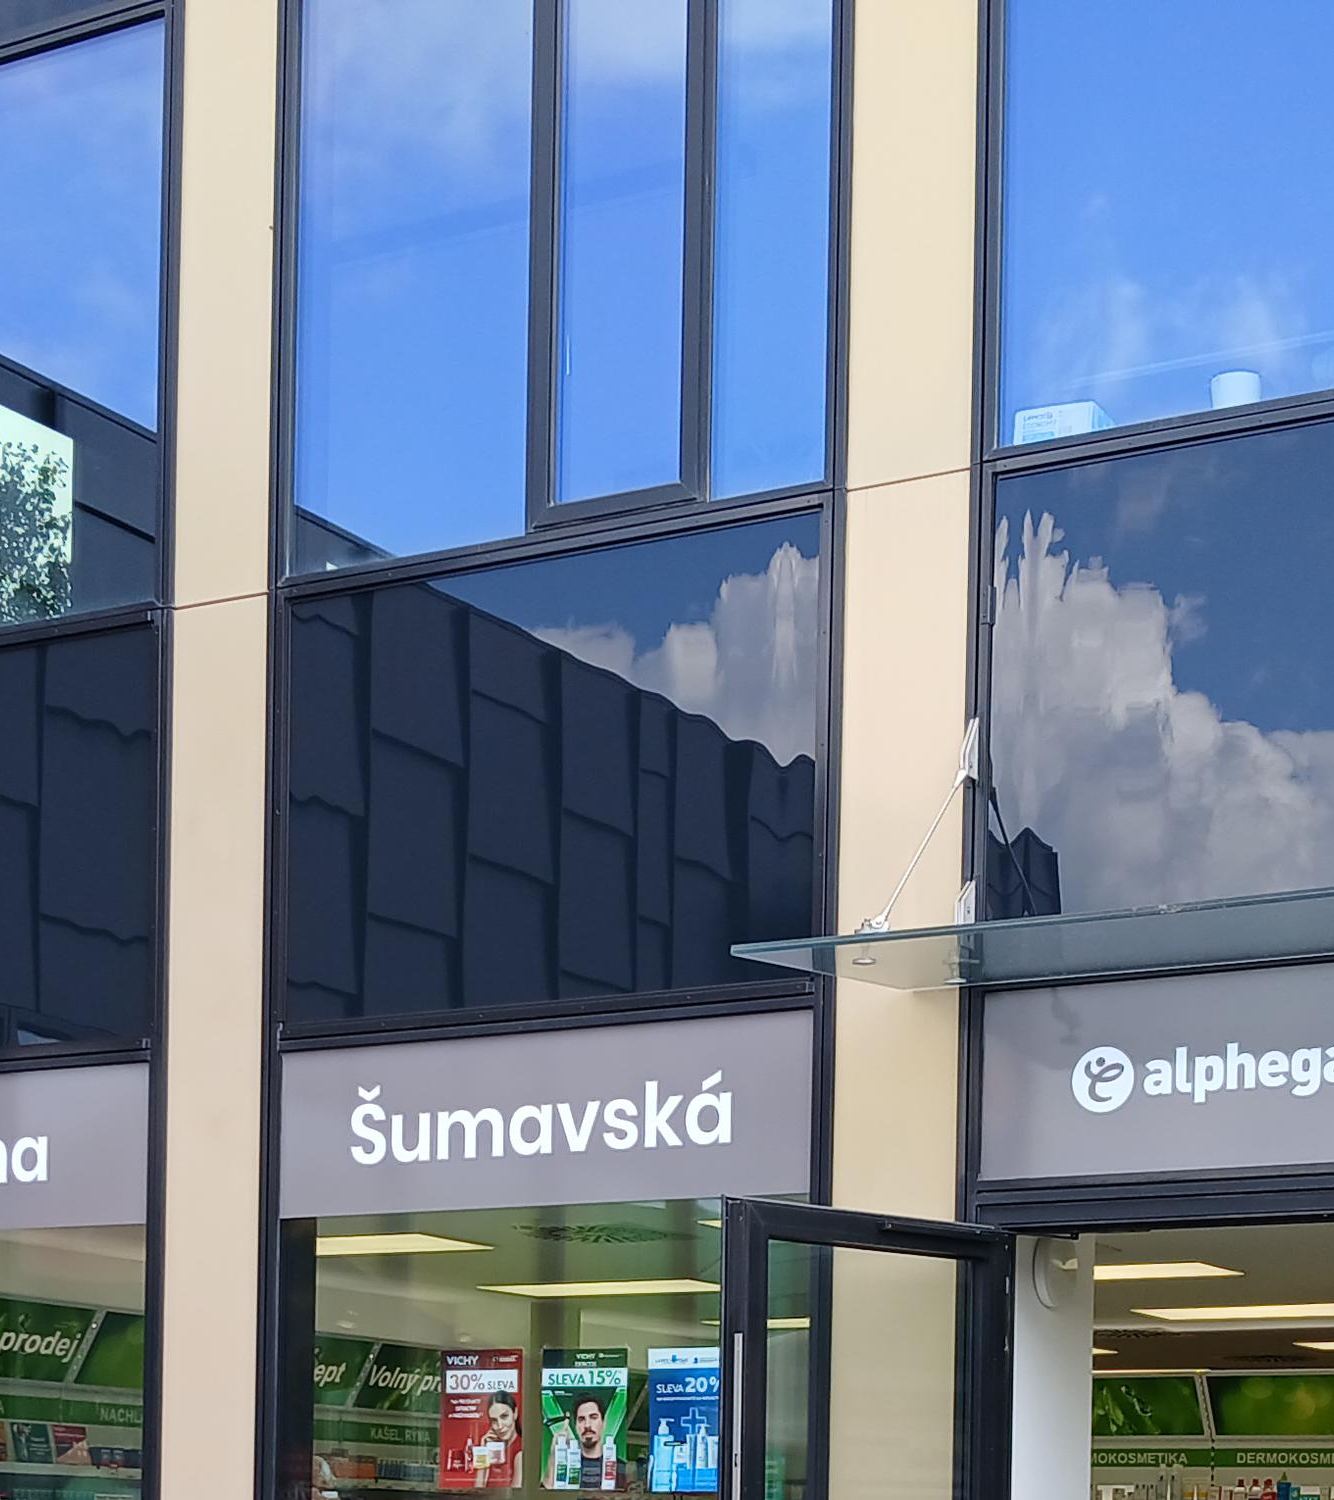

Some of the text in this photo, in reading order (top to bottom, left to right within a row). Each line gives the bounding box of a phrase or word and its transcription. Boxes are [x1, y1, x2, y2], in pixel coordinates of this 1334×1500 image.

[349, 1069, 733, 1166] Šumavská
[446, 1355, 479, 1367] VICHY
[369, 1364, 421, 1394] Volný
[449, 1373, 515, 1390] 30% SLEVA
[548, 1370, 621, 1385] SLEVA 15%
[656, 1384, 684, 1394] SLEVA
